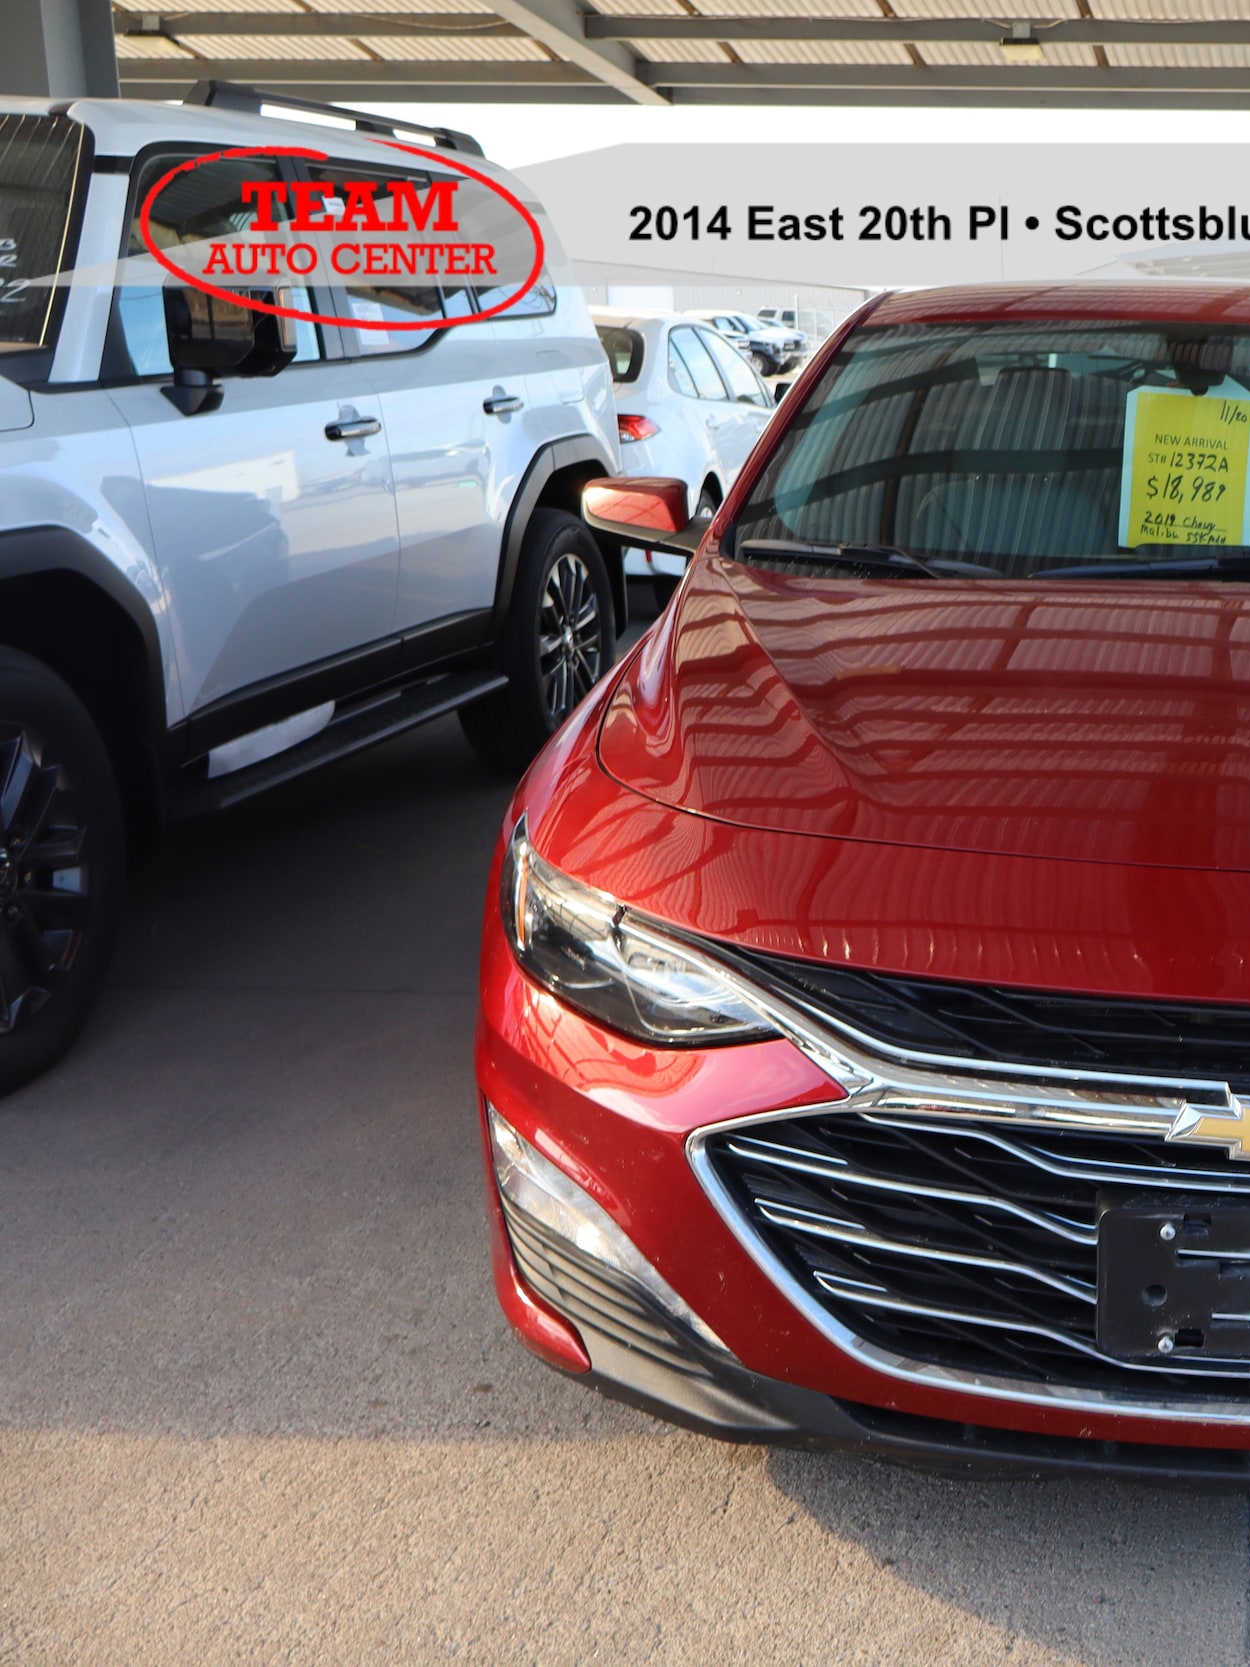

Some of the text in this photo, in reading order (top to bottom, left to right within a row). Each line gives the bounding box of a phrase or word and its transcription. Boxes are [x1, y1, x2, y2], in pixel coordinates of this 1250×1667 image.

[1155, 433, 1228, 450] NEW ARRIVAL
[1169, 451, 1229, 473] 12372A
[1144, 510, 1216, 536] 2019 Chevy
